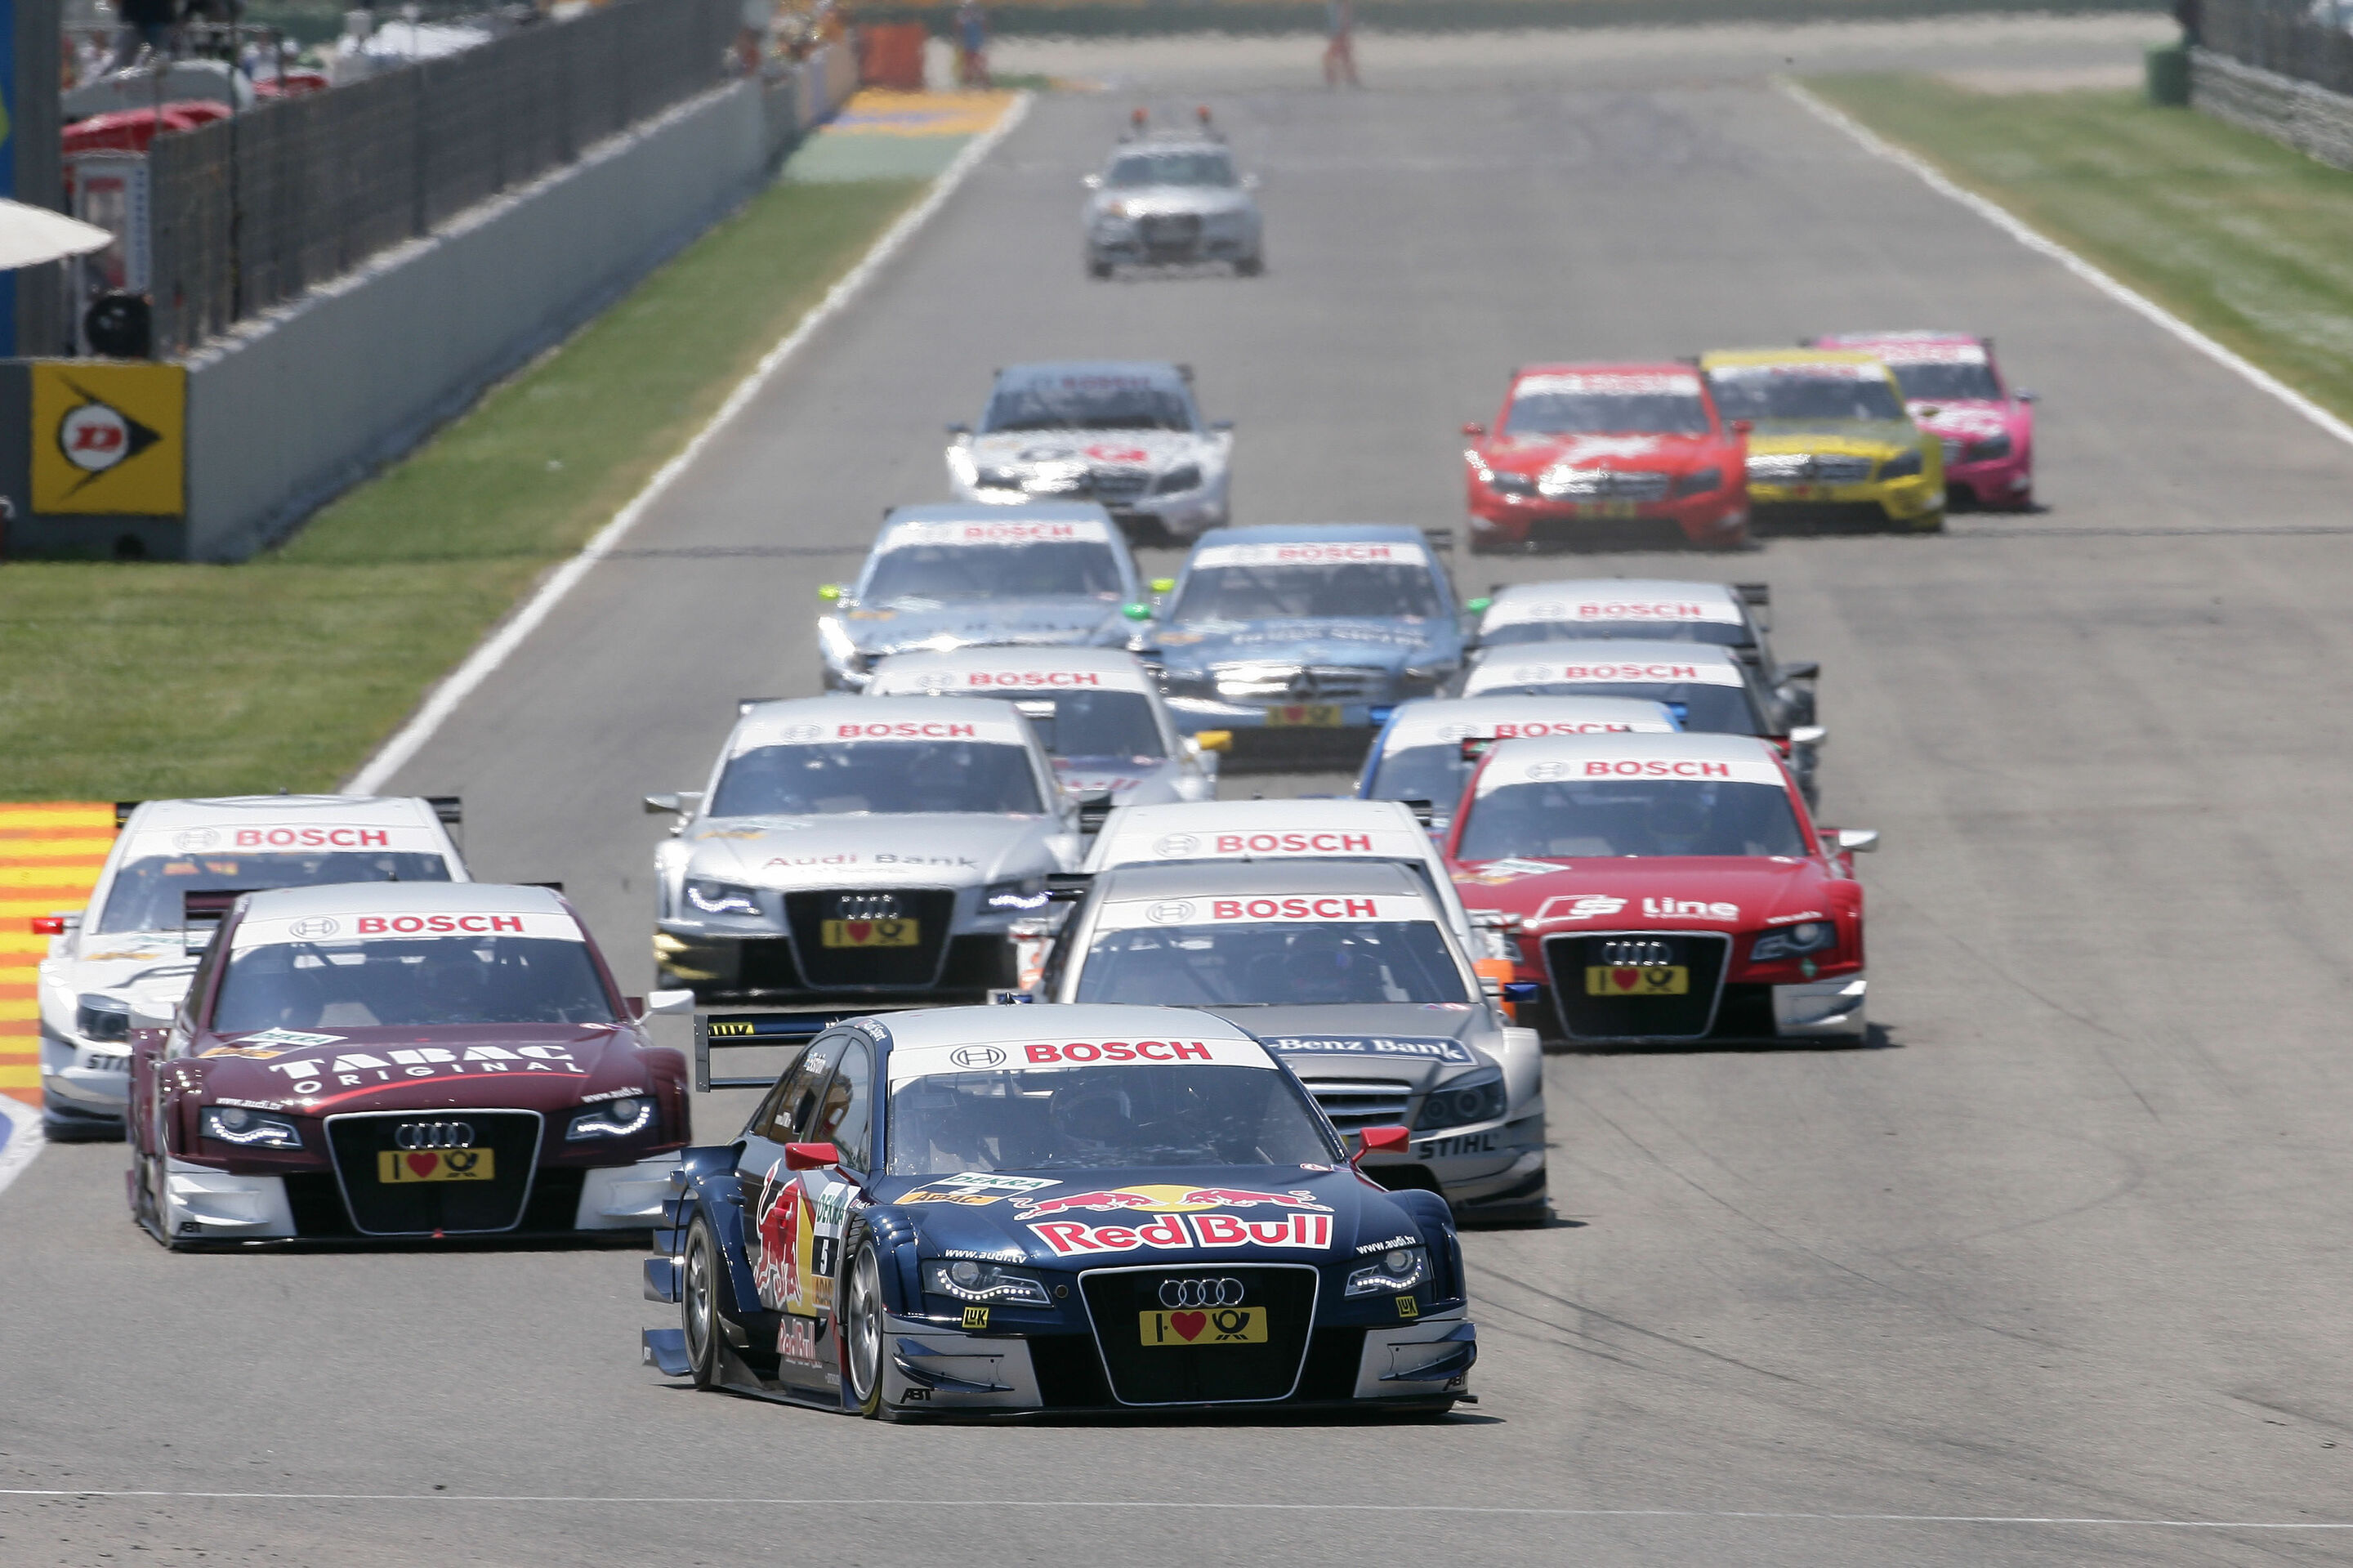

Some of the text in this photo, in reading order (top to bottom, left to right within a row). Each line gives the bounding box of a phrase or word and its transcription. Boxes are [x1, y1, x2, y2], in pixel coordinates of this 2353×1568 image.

[964, 525, 1074, 538] BOSCH
[1278, 546, 1391, 559] BOSCH
[1578, 602, 1702, 618] BOSCH
[969, 672, 1100, 686] BOSCH
[1566, 664, 1697, 679] BOSCH
[837, 724, 975, 738] BOSCH
[1585, 761, 1730, 776] BOSCH
[237, 829, 388, 847] BOSCH
[1217, 834, 1373, 852] BOSCH
[762, 854, 977, 869] Audi Bank
[1214, 898, 1377, 918] BOSCH
[1642, 897, 1739, 916] line
[359, 915, 524, 934] BOSCH
[1025, 1041, 1212, 1065] BOSCH
[1373, 1039, 1465, 1061] Bank
[269, 1046, 574, 1079] TABAC
[292, 1062, 585, 1093] ORIGINAL
[1418, 1134, 1495, 1159] STIHL
[947, 1175, 1045, 1188] DEKRA
[910, 1193, 983, 1204] ADAC
[817, 1194, 846, 1226] DEKRA
[1031, 1213, 1333, 1254] Red Bull
[1355, 1235, 1417, 1255] www.audi.tv
[819, 1240, 829, 1275] 5
[944, 1249, 1028, 1264] www.audi.tv
[1442, 1375, 1466, 1392] ABT
[900, 1388, 932, 1404] ABT
